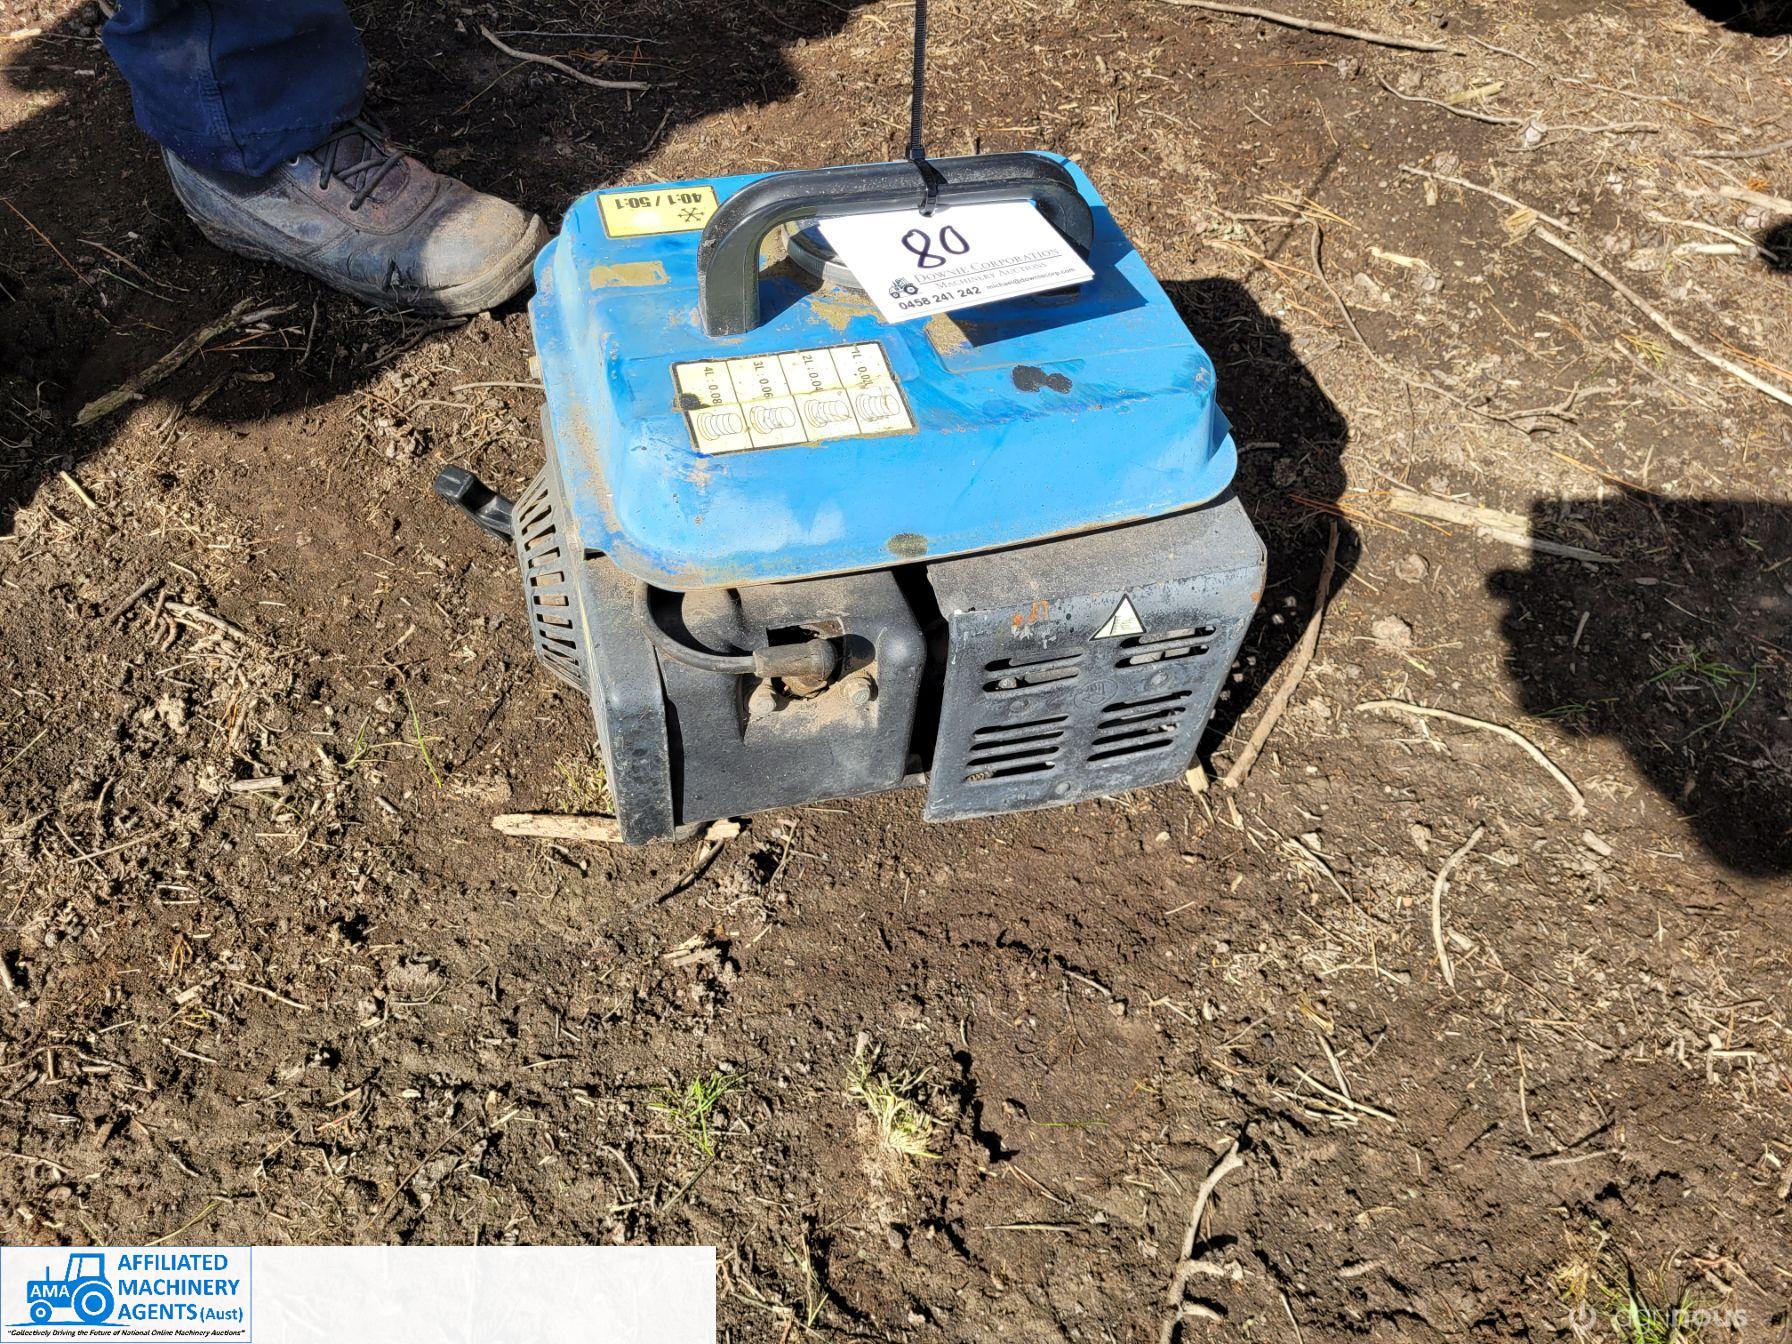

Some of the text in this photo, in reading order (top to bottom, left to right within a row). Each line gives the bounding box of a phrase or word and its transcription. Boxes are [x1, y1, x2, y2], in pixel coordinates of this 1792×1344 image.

[614, 192, 702, 210] 40:1 / 50:1
[901, 225, 970, 269] 80
[914, 248, 1060, 284] DOWNIE CORPORATION
[935, 261, 1048, 291] MACHINERY AUCTIONS
[898, 286, 982, 311] 0458 241 242
[703, 366, 715, 377] 4L
[802, 354, 814, 366] 2L
[753, 361, 765, 372] 3L
[759, 378, 774, 400] 0.06
[708, 384, 723, 405] 0.08
